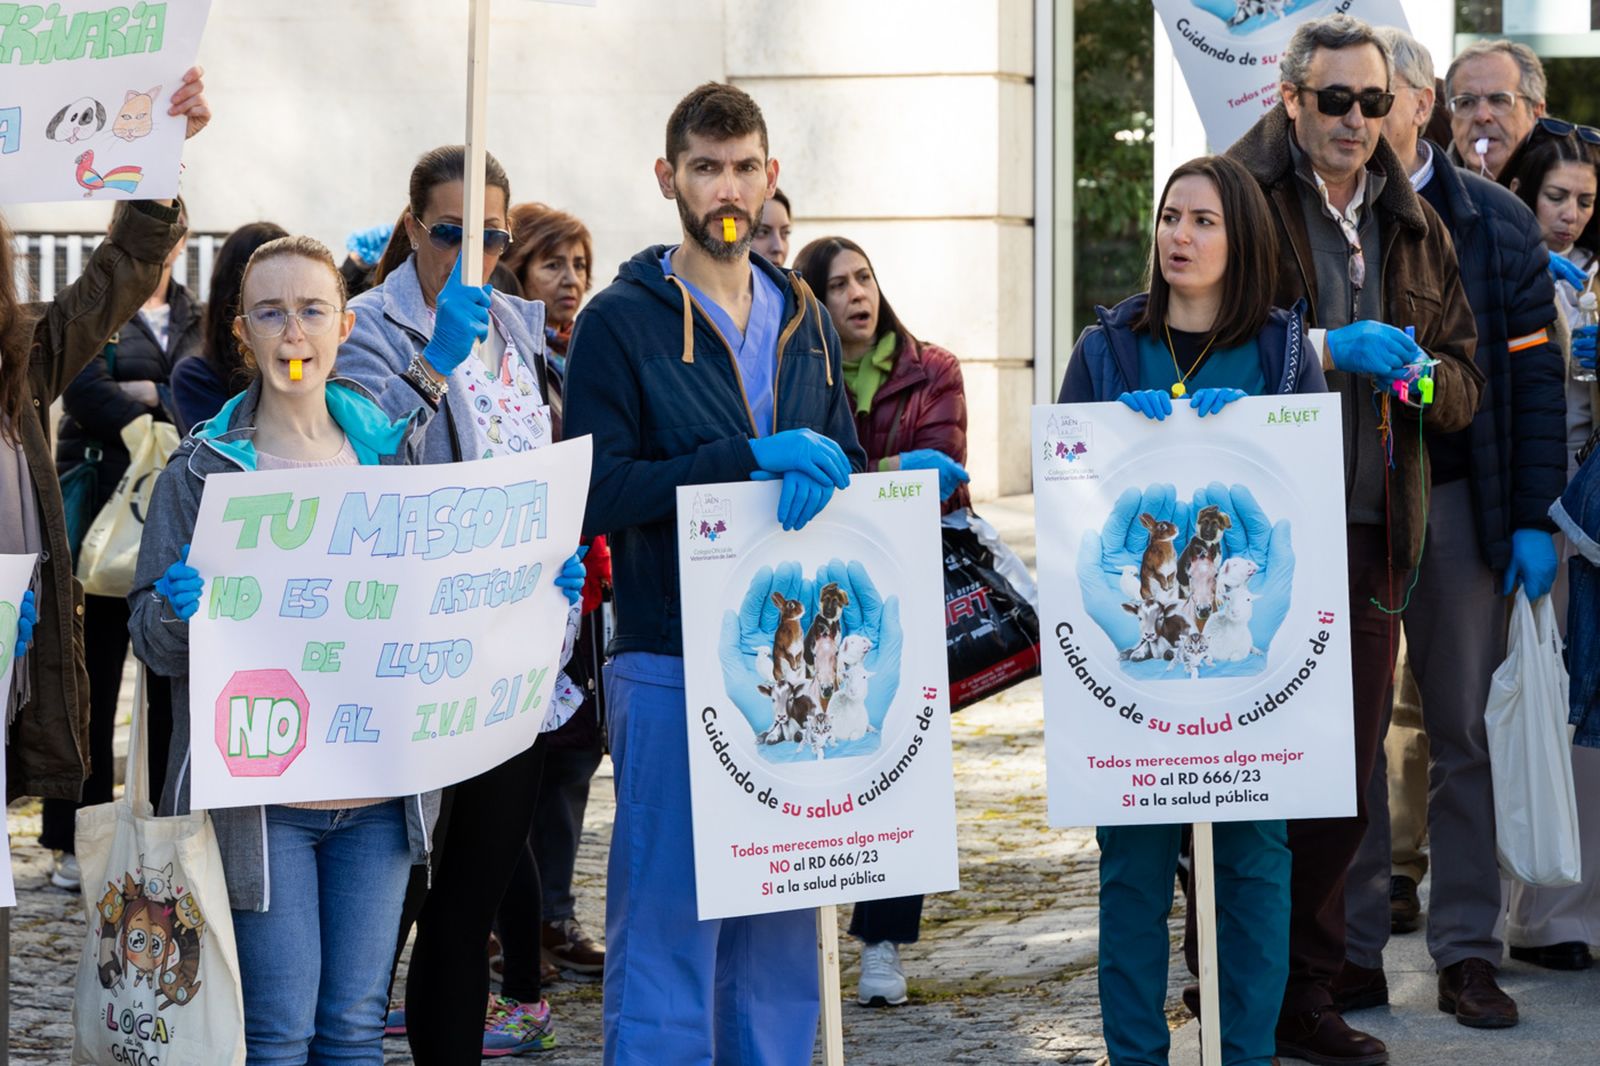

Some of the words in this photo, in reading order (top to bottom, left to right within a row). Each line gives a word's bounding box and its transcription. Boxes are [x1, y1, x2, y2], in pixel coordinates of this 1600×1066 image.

[1176, 18, 1235, 63] Cuidando
[1239, 52, 1257, 66] de
[1261, 55, 1277, 65] su
[1227, 92, 1259, 108] Todos
[222, 491, 320, 550] TU
[327, 480, 549, 560] MASCOTA
[208, 576, 262, 621] NO
[279, 578, 332, 618] ES
[344, 580, 399, 620] UN
[429, 562, 543, 615] ARTÍCULO
[1318, 610, 1335, 624] ti
[1312, 630, 1330, 655] de
[301, 641, 345, 673] DE
[375, 638, 473, 685] LUJO
[1055, 621, 1116, 708] Cuidando
[923, 686, 938, 700] ti
[1238, 658, 1316, 727] cuidamos
[914, 706, 934, 732] de
[1119, 703, 1144, 724] de
[1148, 717, 1171, 733] su
[1176, 712, 1232, 736] salud
[228, 696, 301, 758] NO
[325, 704, 380, 743] AL
[701, 706, 755, 794] Cuidando
[1087, 755, 1131, 769] Todos
[1135, 754, 1220, 767] merecemos
[1224, 750, 1257, 767] algo
[1261, 749, 1304, 765] mejor
[857, 734, 923, 806] cuidamos
[1132, 773, 1157, 787] NO
[1160, 772, 1174, 786] al
[1178, 772, 1198, 785] RD
[1202, 769, 1261, 785] 666/23
[757, 789, 778, 809] de
[782, 802, 801, 816] su
[806, 794, 854, 818] salud
[1122, 794, 1136, 807] SI
[1139, 797, 1149, 806] a
[1153, 793, 1167, 806] la
[1171, 791, 1211, 805] salud
[1215, 789, 1269, 806] pública
[731, 843, 769, 858] Todos
[772, 838, 844, 854] merecemos
[847, 832, 874, 848] algo
[877, 827, 914, 844] mejor
[769, 860, 791, 874] NO
[793, 857, 805, 871] al
[808, 856, 826, 869] RD
[829, 850, 879, 867] 666/23
[761, 882, 773, 896] SI
[776, 885, 785, 894] a
[788, 879, 800, 893] la
[803, 874, 837, 891] salud
[840, 870, 885, 889] pública
[132, 1000, 144, 1009] LA
[106, 1003, 169, 1044] LOCA
